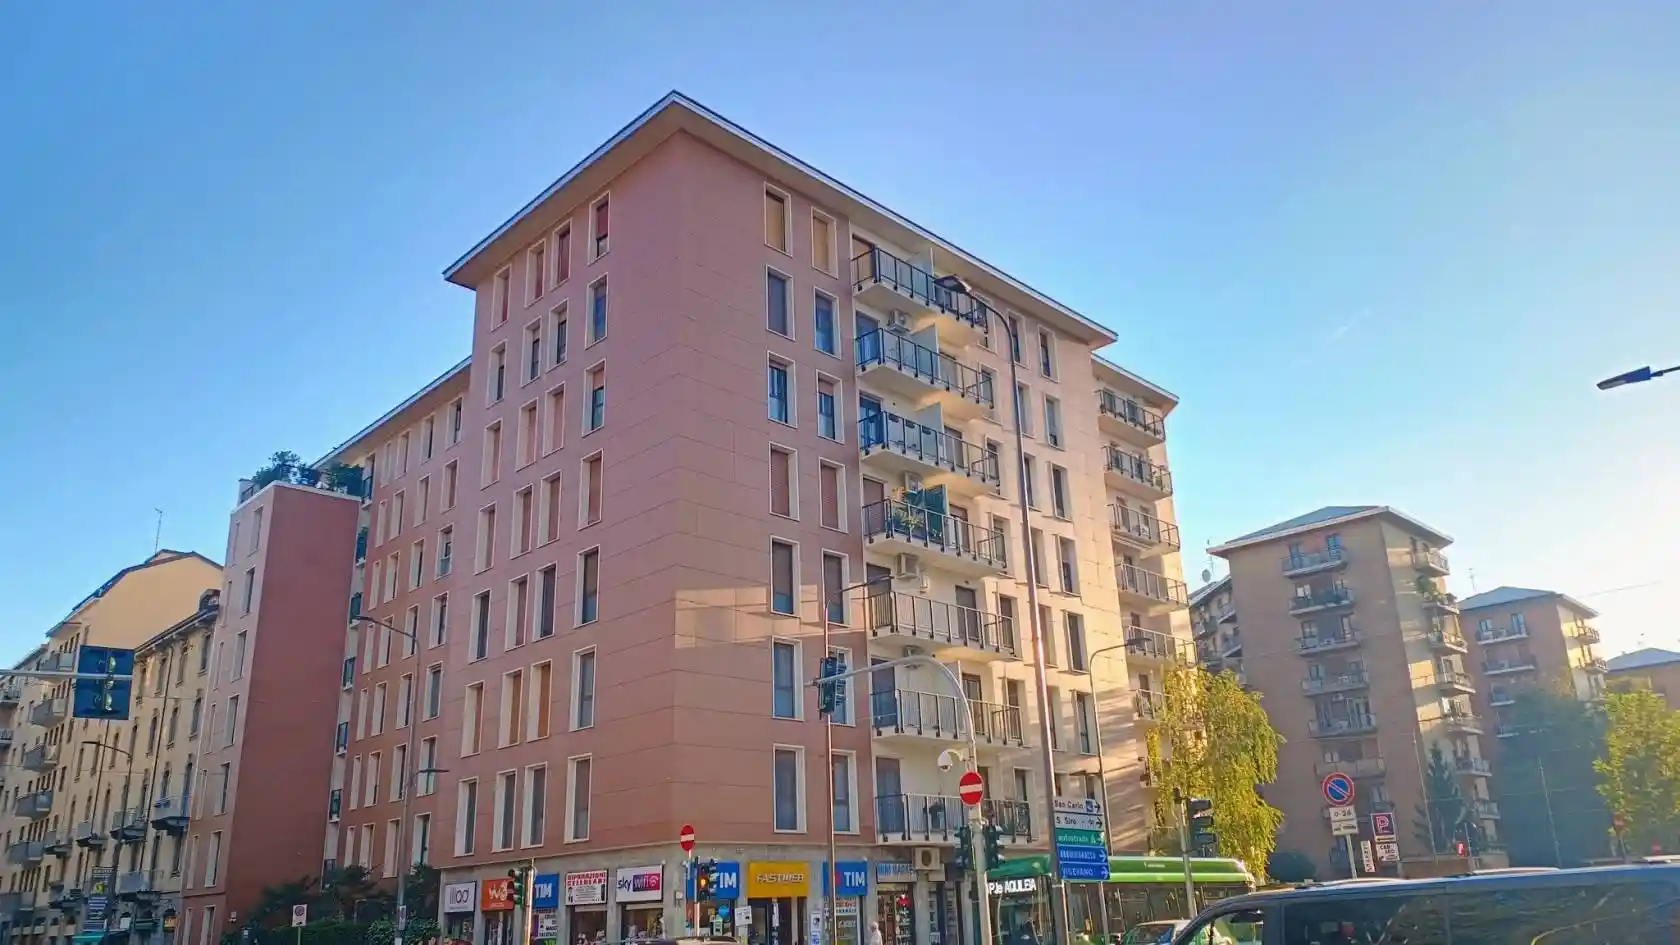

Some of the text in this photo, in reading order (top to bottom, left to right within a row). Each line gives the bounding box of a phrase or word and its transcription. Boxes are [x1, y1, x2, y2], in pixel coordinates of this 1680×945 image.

[1054, 800, 1084, 809] San Carlo
[1064, 816, 1077, 825] Siro
[617, 876, 632, 891] sky
[756, 873, 804, 884] FASTWEB
[844, 872, 866, 887] TIM
[535, 883, 552, 899] TIM
